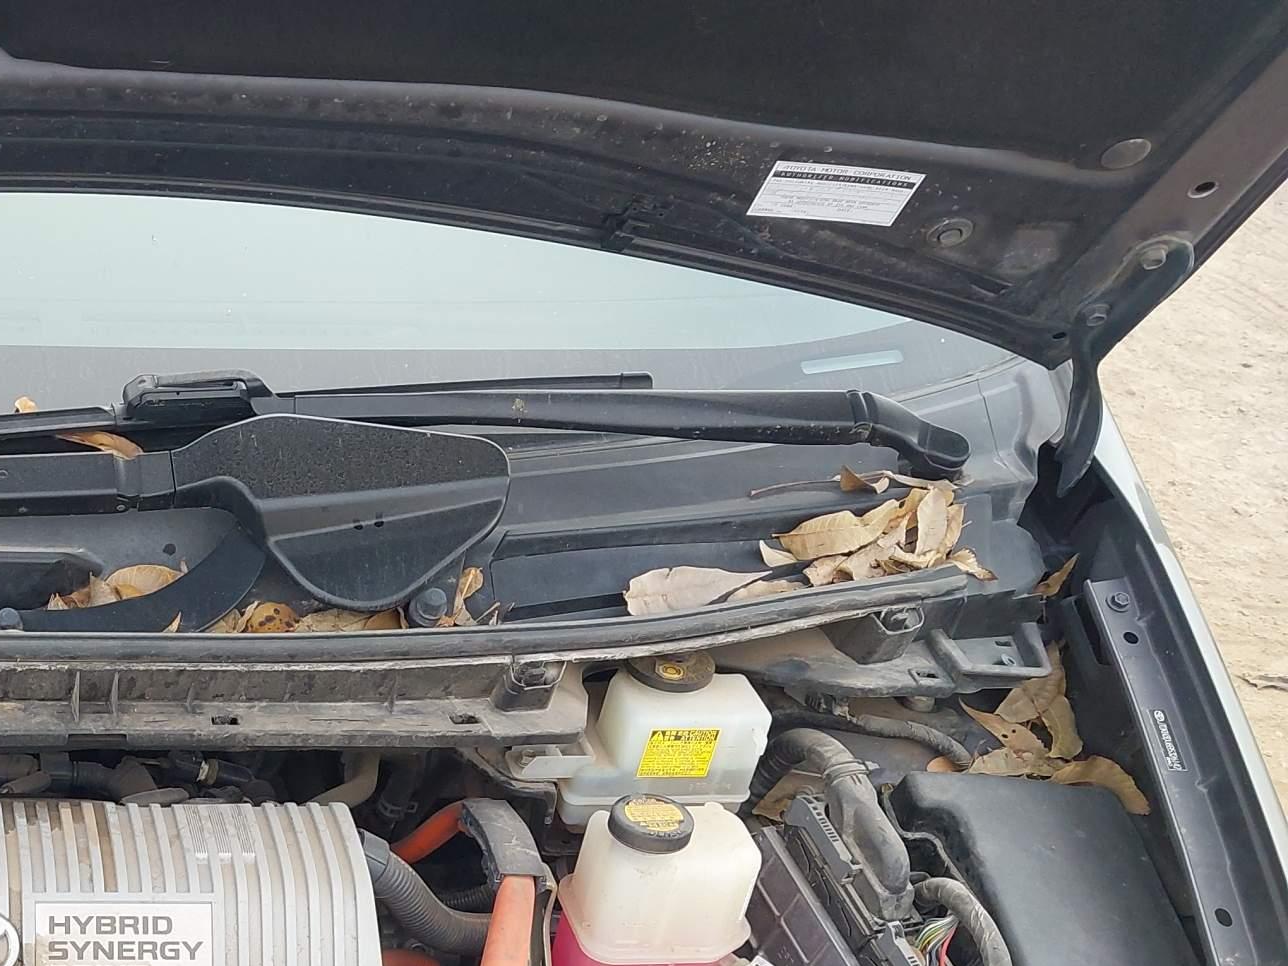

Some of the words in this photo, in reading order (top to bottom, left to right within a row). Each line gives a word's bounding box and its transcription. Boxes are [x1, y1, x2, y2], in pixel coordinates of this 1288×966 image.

[780, 171, 833, 181] AUTHORIZED
[839, 175, 909, 187] MODIFICATIONS
[821, 167, 849, 175] MOTOR
[853, 170, 912, 181] CORPORATION
[48, 916, 173, 935] HYBRID
[48, 941, 204, 961] SYNERGY
